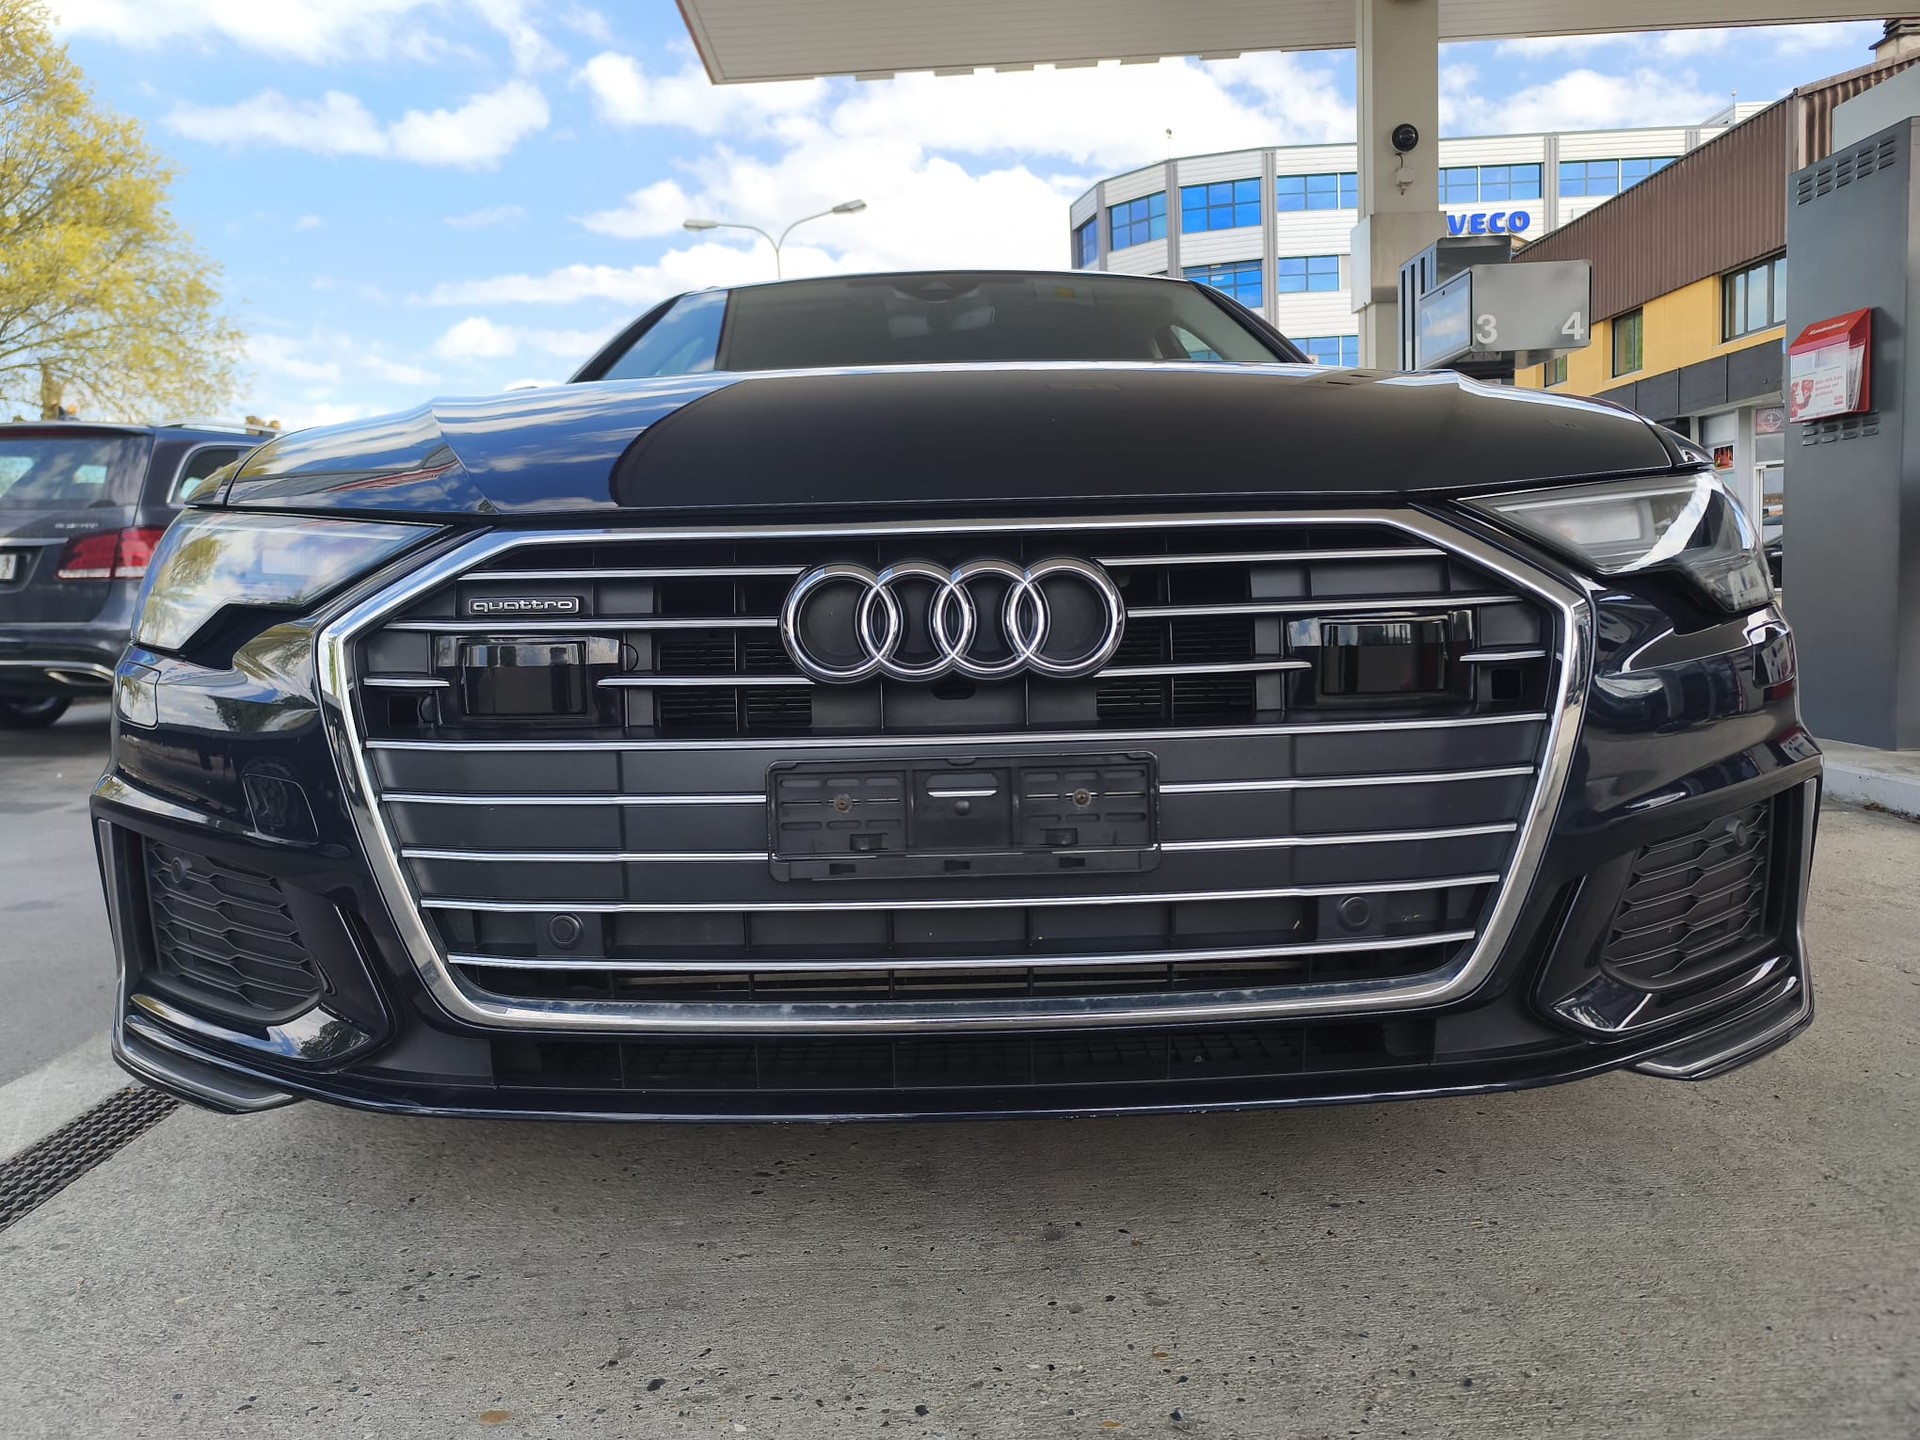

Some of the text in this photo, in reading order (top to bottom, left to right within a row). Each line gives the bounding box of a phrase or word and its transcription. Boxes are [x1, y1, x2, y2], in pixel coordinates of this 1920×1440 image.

[1447, 211, 1531, 235] VECO
[1476, 314, 1498, 344] 3
[1561, 311, 1584, 340] 4
[473, 600, 573, 612] quattro
